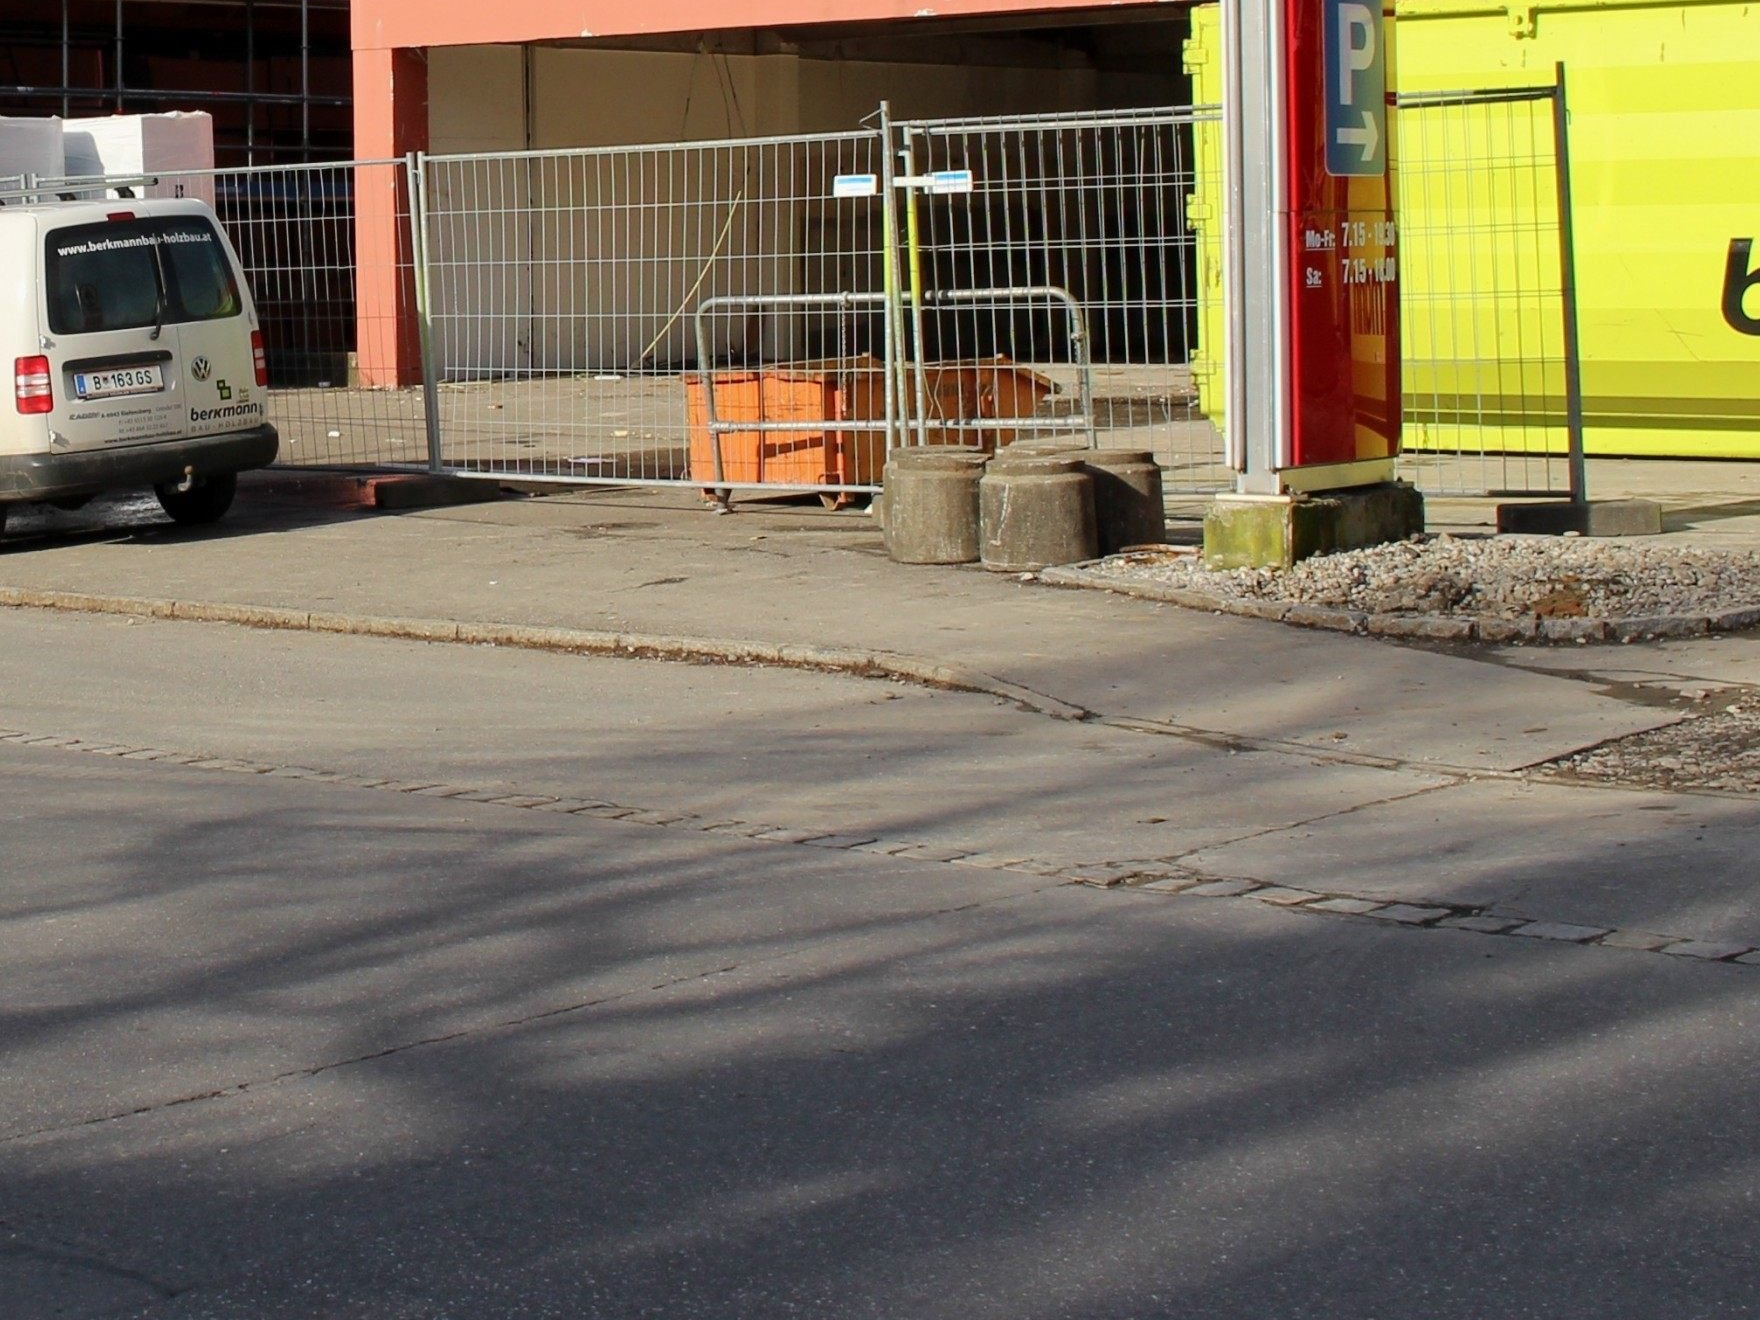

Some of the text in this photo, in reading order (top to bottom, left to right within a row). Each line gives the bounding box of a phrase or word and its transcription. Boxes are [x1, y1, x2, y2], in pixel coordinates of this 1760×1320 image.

[1338, 2, 1375, 105] P
[1305, 230, 1336, 248] Mo-Fr:
[1341, 222, 1366, 247] 7.15
[1306, 267, 1322, 285] Sa:
[1341, 259, 1367, 284] 7.15
[93, 369, 153, 390] B 163 GS
[190, 402, 258, 422] berkmann
